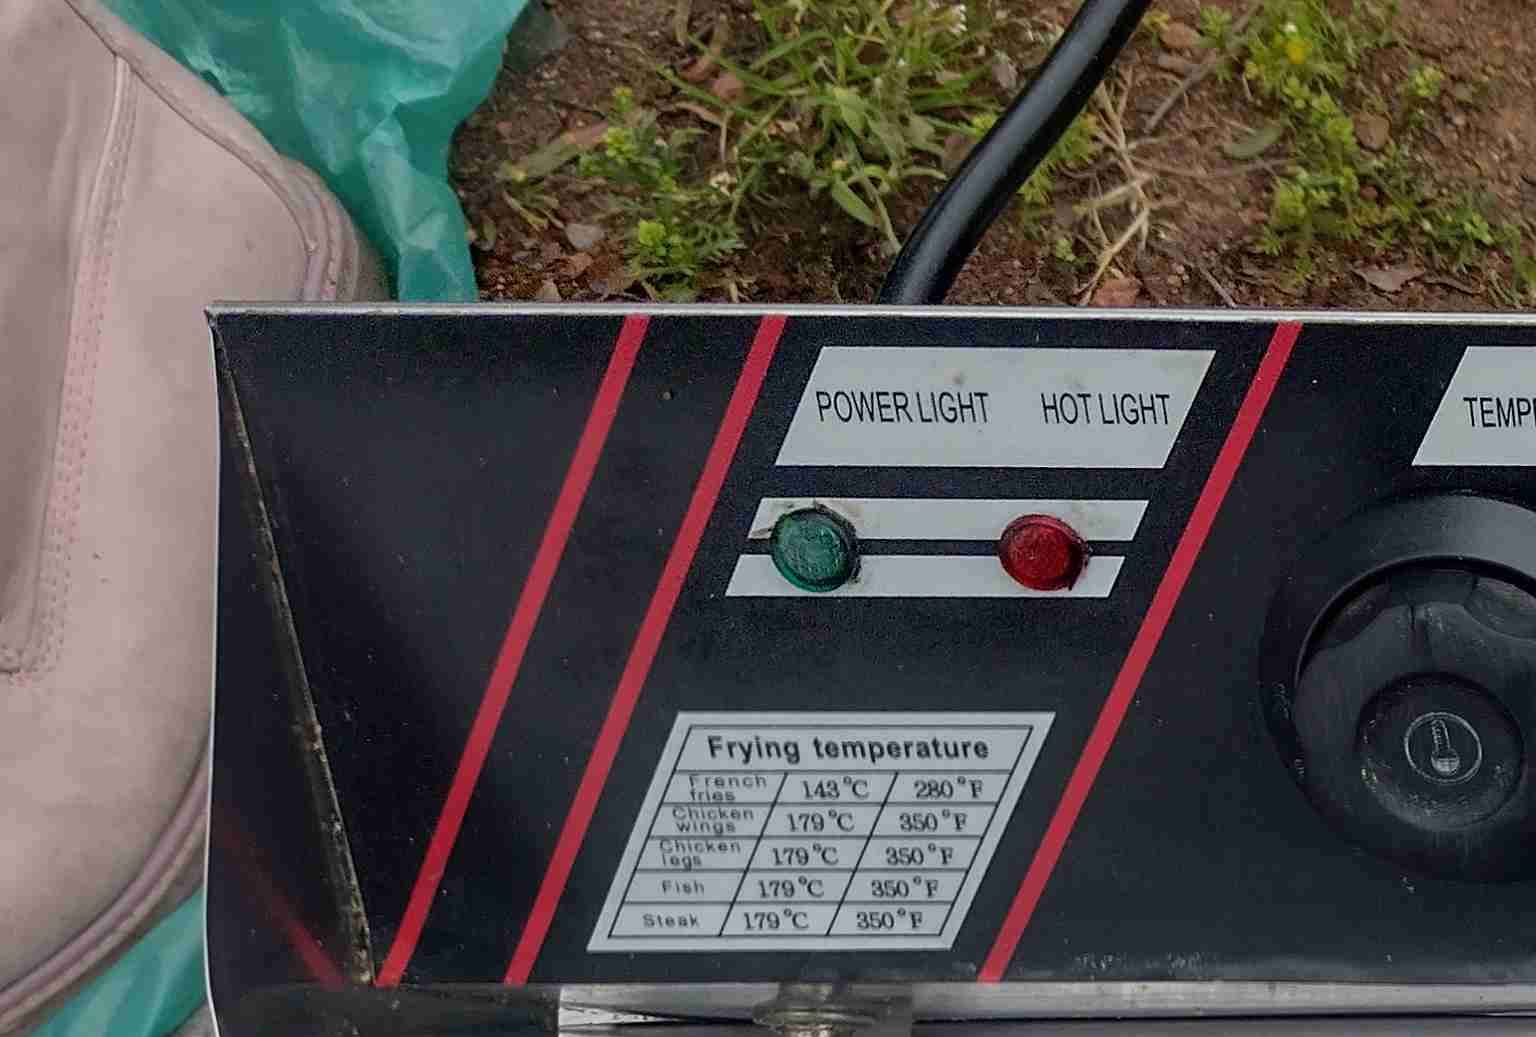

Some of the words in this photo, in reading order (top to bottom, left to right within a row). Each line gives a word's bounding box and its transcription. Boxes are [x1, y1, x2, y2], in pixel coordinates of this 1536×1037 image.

[817, 391, 912, 424] POWER
[920, 391, 989, 424] LIGHT
[1042, 392, 1092, 424] HOT
[1099, 394, 1171, 425] LIGHT
[708, 736, 800, 764] Frying
[813, 737, 989, 763] temperature
[672, 807, 754, 821] Chicken
[676, 820, 736, 835] wings
[659, 839, 741, 854] Chicken
[662, 880, 705, 895] Fish
[643, 912, 699, 928] Steak
